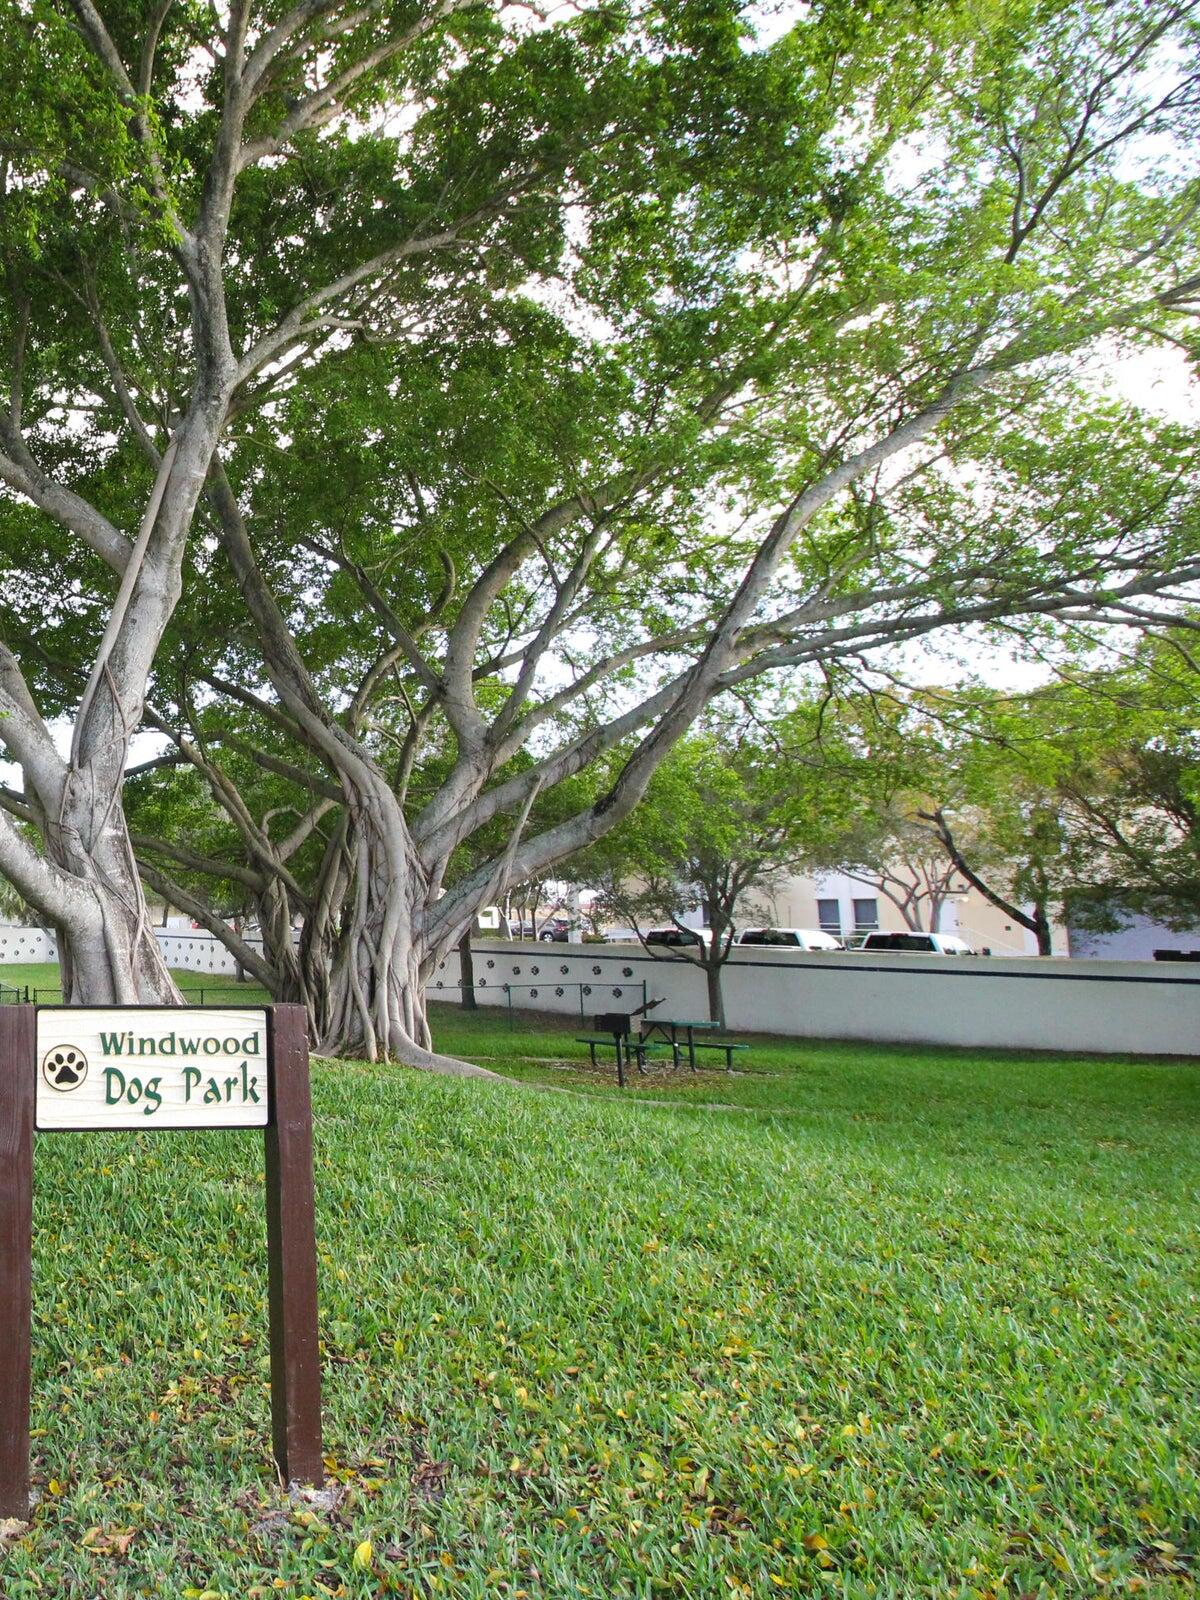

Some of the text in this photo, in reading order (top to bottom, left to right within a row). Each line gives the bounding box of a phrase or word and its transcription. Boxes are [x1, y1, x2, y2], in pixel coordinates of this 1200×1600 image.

[99, 1031, 260, 1056] Windwood
[102, 1060, 261, 1116] Dog Park
